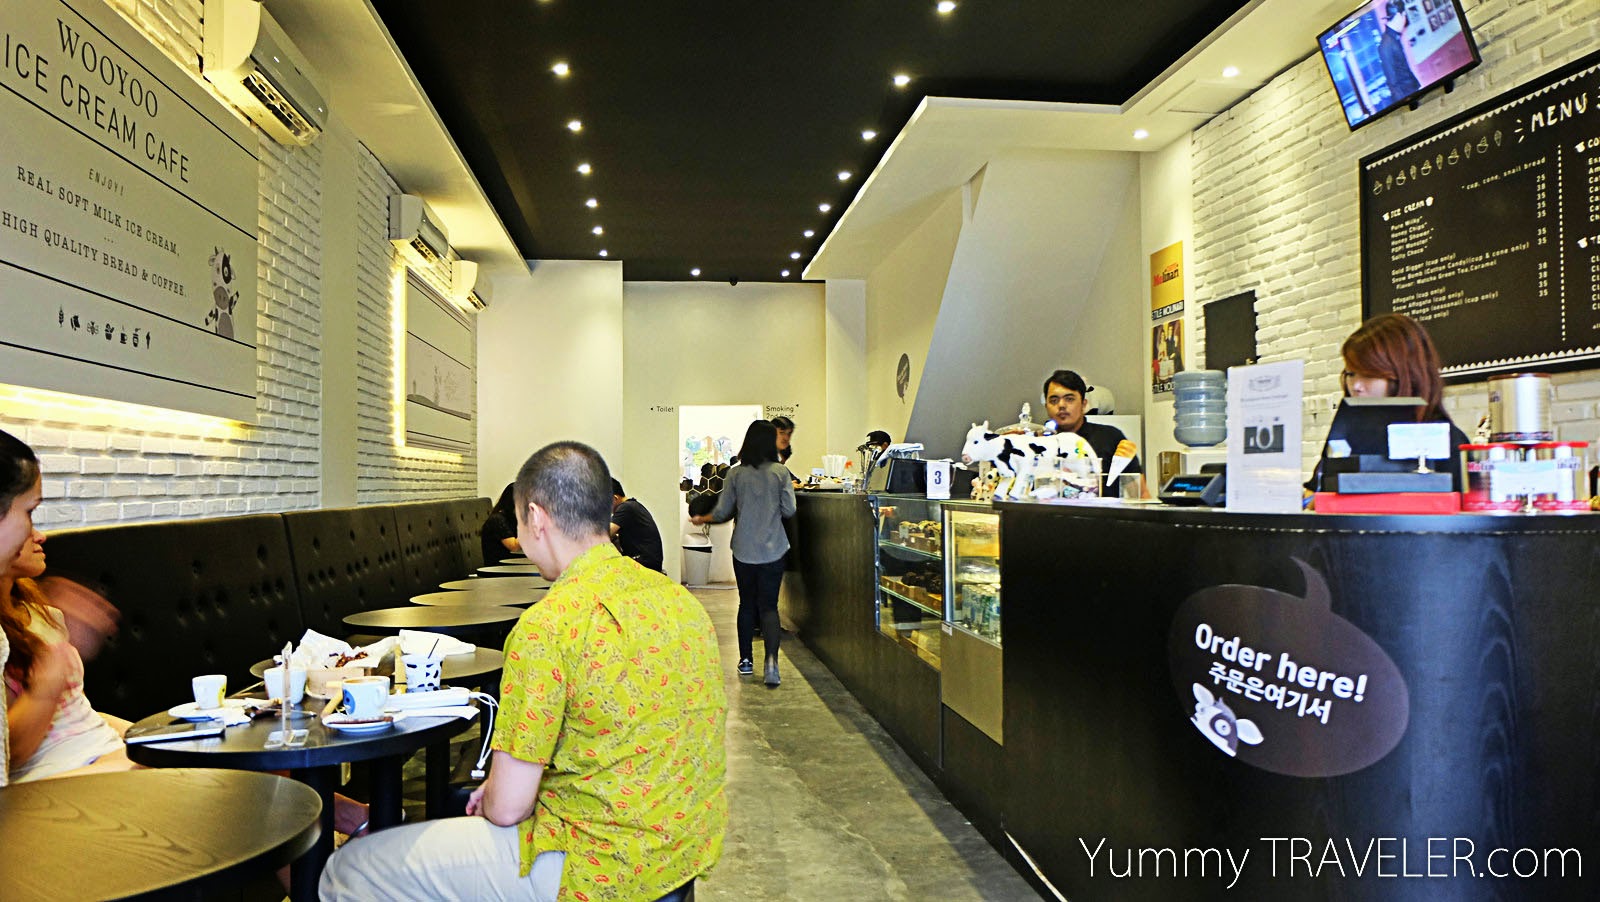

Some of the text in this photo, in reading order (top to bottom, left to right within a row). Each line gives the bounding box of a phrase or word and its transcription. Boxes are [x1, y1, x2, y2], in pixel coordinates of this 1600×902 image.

[57, 18, 158, 117] WOOYOO
[5, 34, 188, 183] ICE CREAM CAFE
[1531, 92, 1588, 132] MENU
[88, 168, 125, 196] ENJOY!
[1523, 156, 1546, 170] bread
[17, 165, 53, 195] REAL
[58, 186, 89, 211] SOFT
[93, 203, 122, 228] MILK
[125, 219, 142, 238] ICE
[1390, 200, 1425, 218] ICE CREAM
[1, 210, 38, 239] HIGH
[44, 229, 98, 261] QUALITY
[102, 250, 138, 277] BREAD
[141, 268, 149, 280] &
[766, 405, 794, 413] Smoking
[934, 470, 942, 485] 3
[1195, 623, 1368, 703] Order here!
[1208, 661, 1332, 724] 주문은여기서
